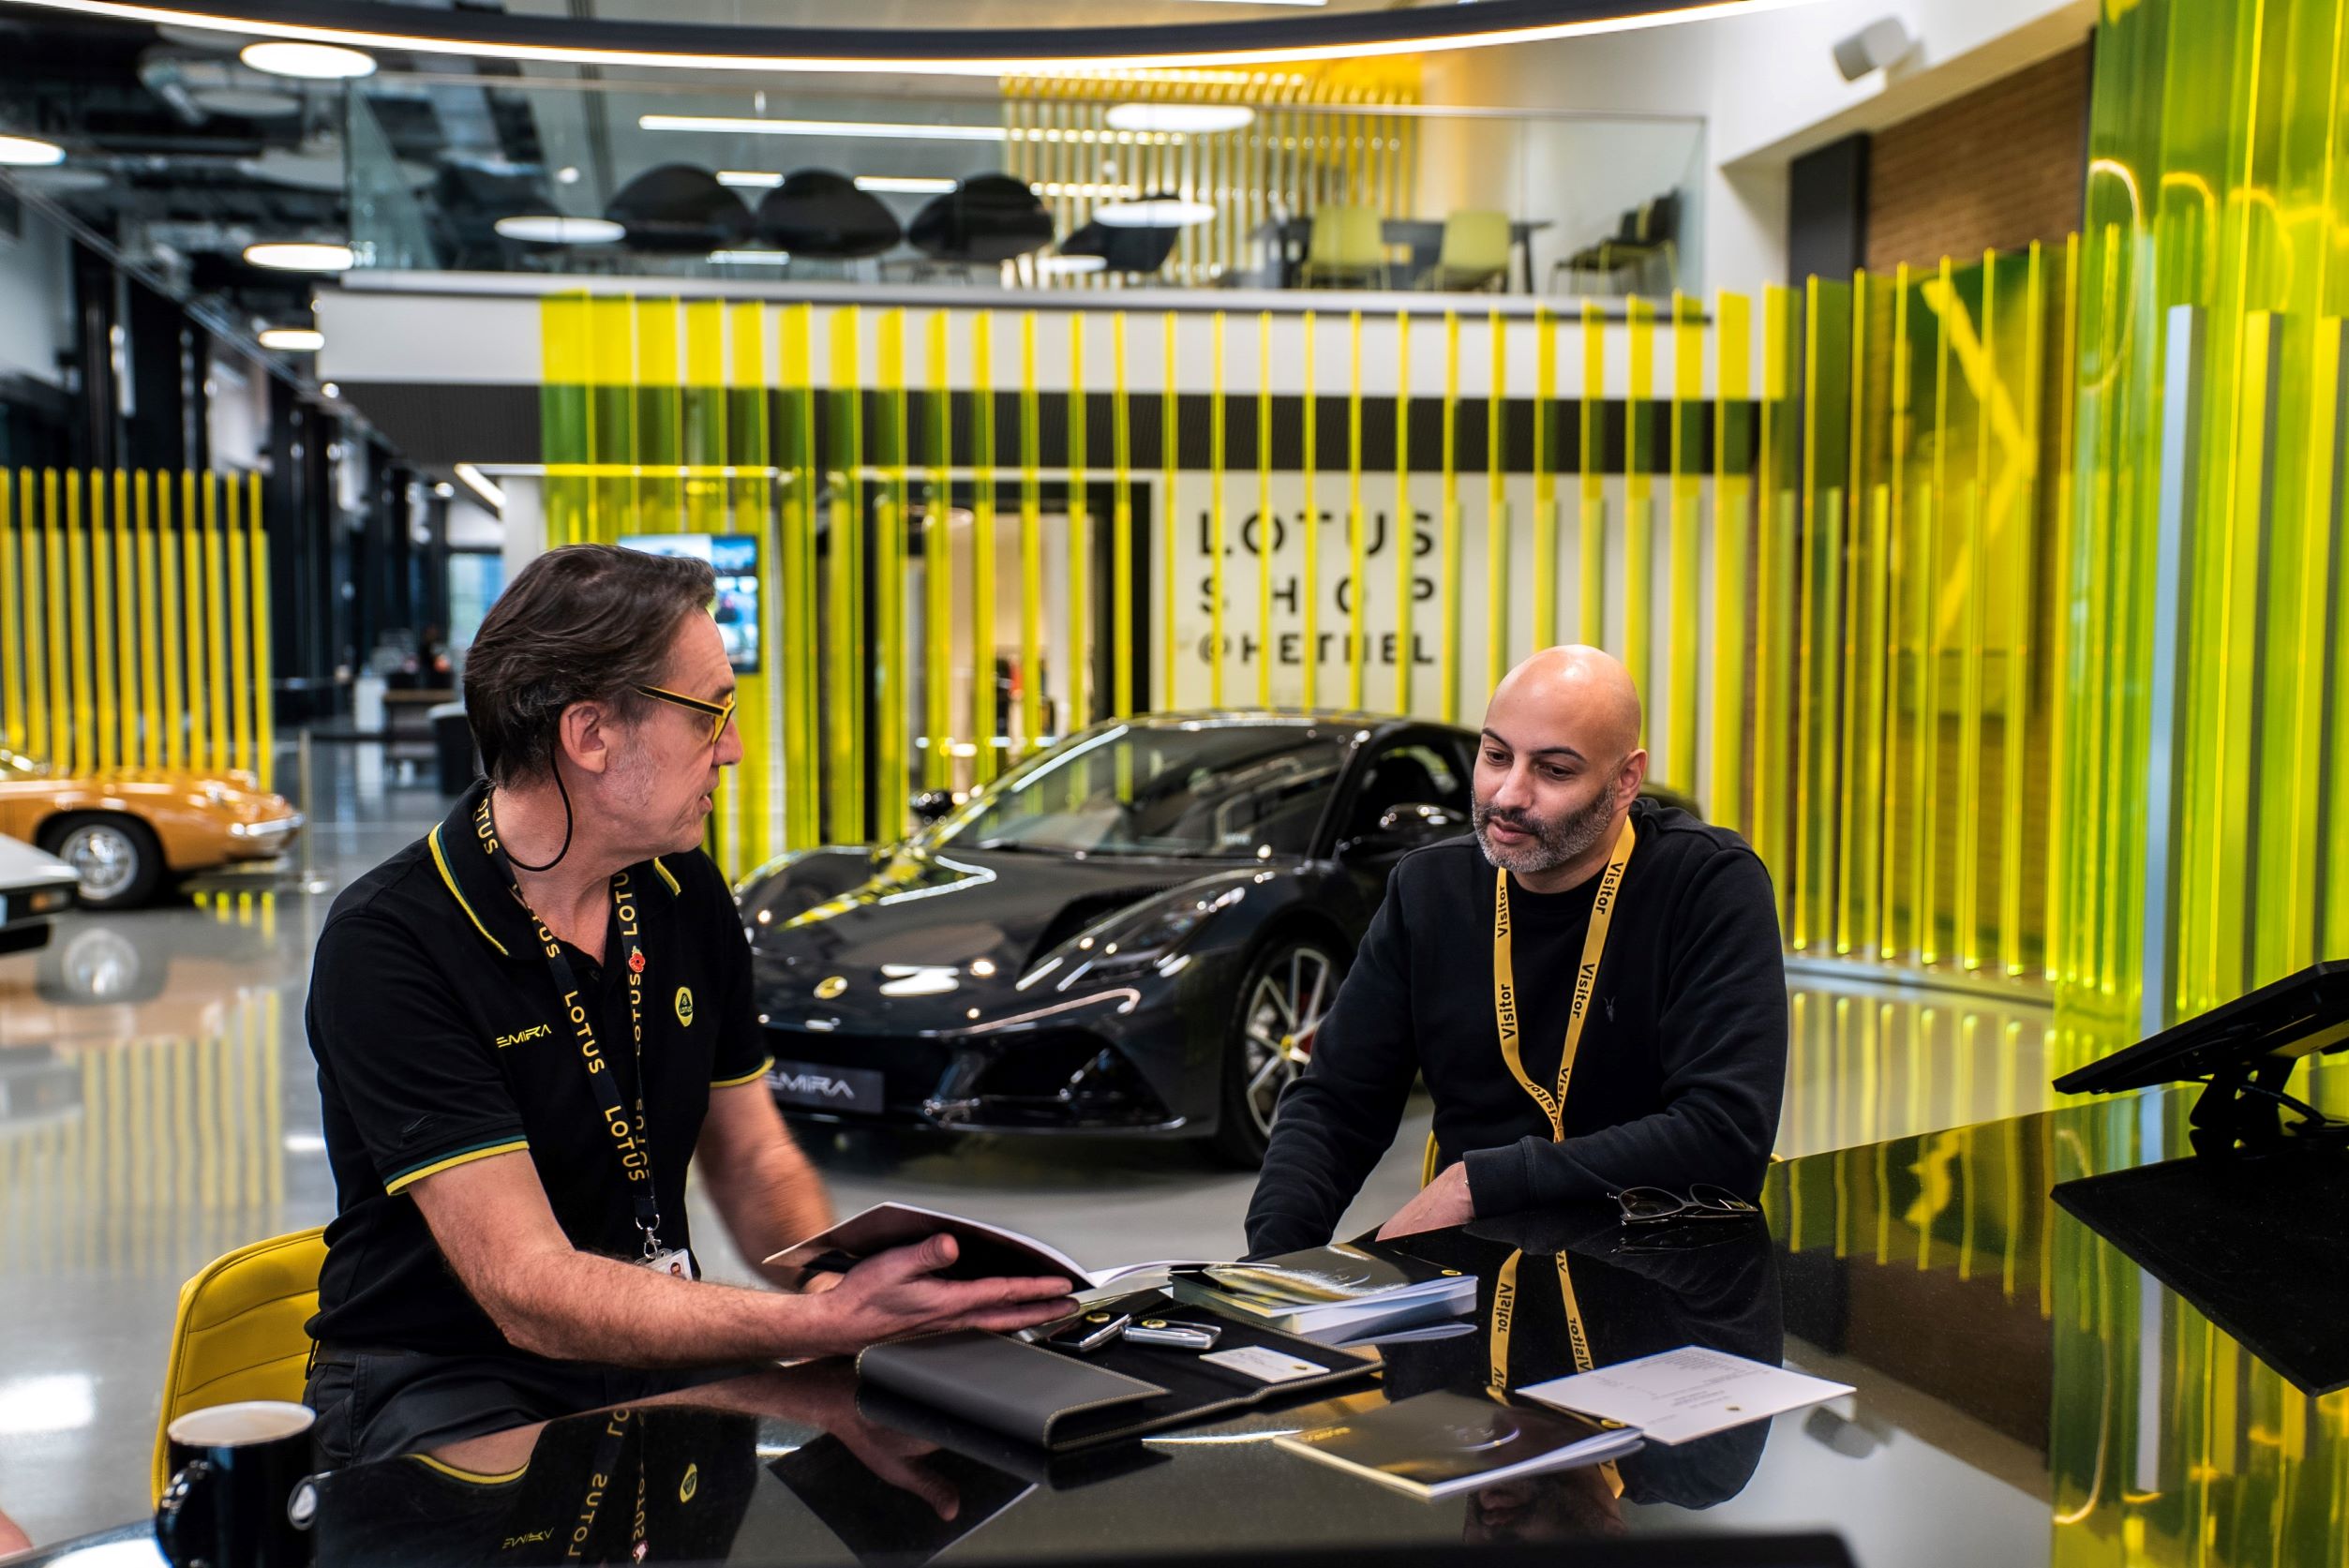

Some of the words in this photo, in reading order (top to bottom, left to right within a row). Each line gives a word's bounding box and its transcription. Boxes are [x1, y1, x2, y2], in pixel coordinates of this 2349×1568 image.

[475, 798, 499, 855] OTUS
[614, 872, 638, 936] LOTU
[1497, 885, 1508, 938] Visitor
[1596, 861, 1624, 915] Visitor
[1500, 984, 1516, 1039] Visitor
[1572, 963, 1595, 1019] Visitor
[496, 1024, 552, 1048] EMIRA
[564, 991, 605, 1074] LOTUS
[766, 1070, 855, 1099] EMIRA
[605, 1105, 645, 1181] LOTUS
